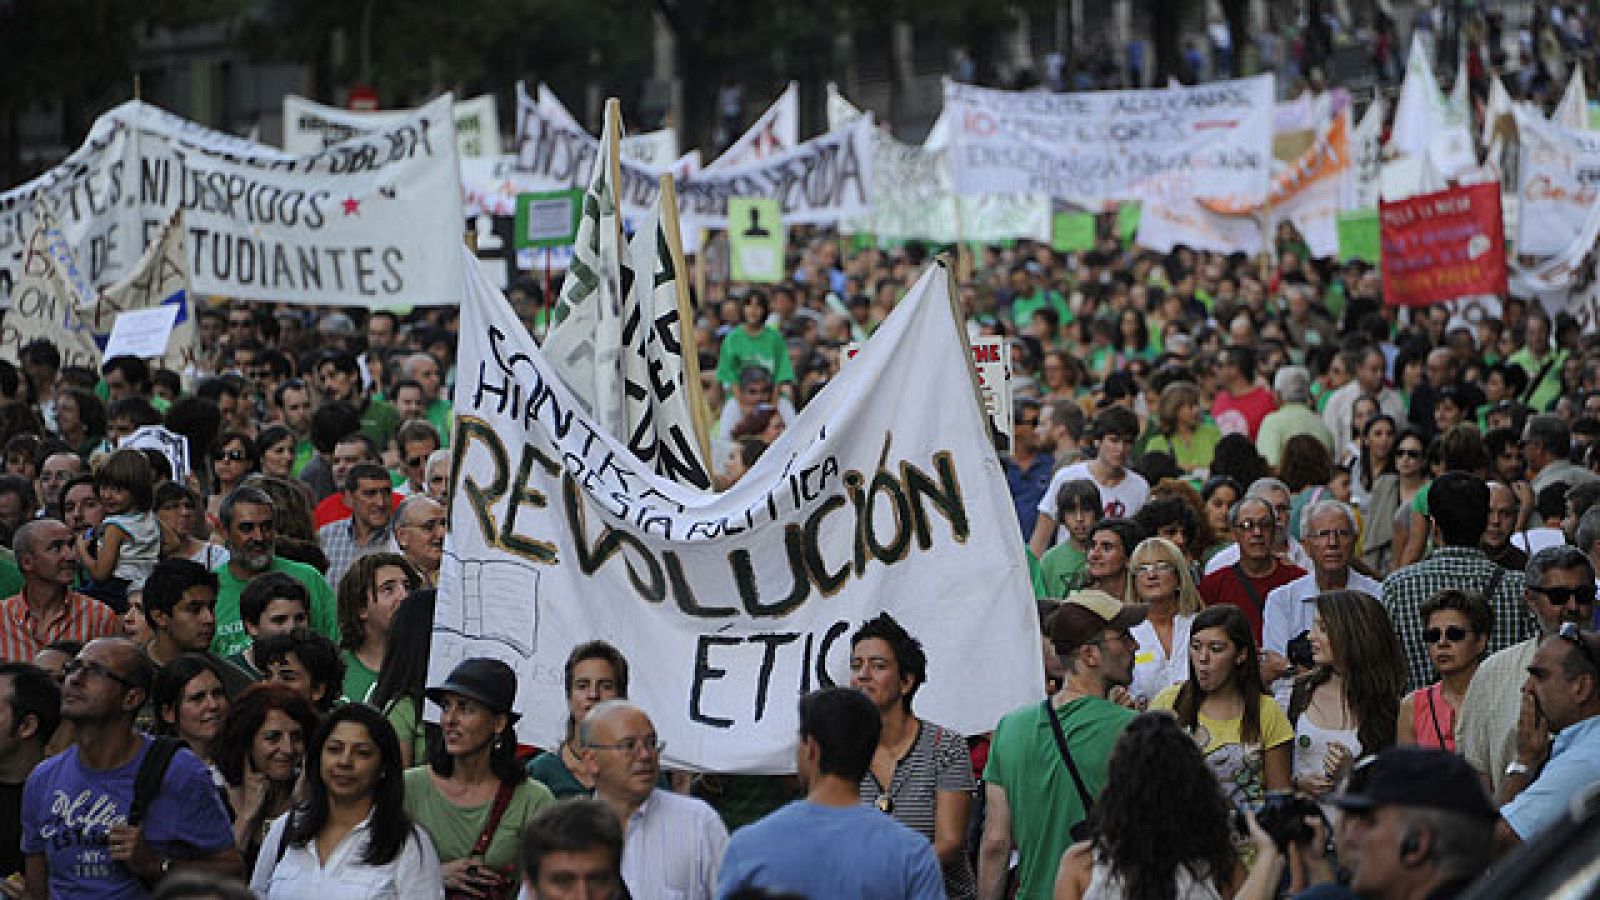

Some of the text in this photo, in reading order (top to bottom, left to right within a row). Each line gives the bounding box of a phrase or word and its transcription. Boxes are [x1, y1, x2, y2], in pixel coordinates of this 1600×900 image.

[141, 156, 170, 206] NI
[174, 150, 330, 229] DESPIDOS
[143, 218, 405, 296] ETUDIANTES
[449, 414, 970, 618] REVOLUCIÓN
[690, 621, 851, 728] ÉTIC
